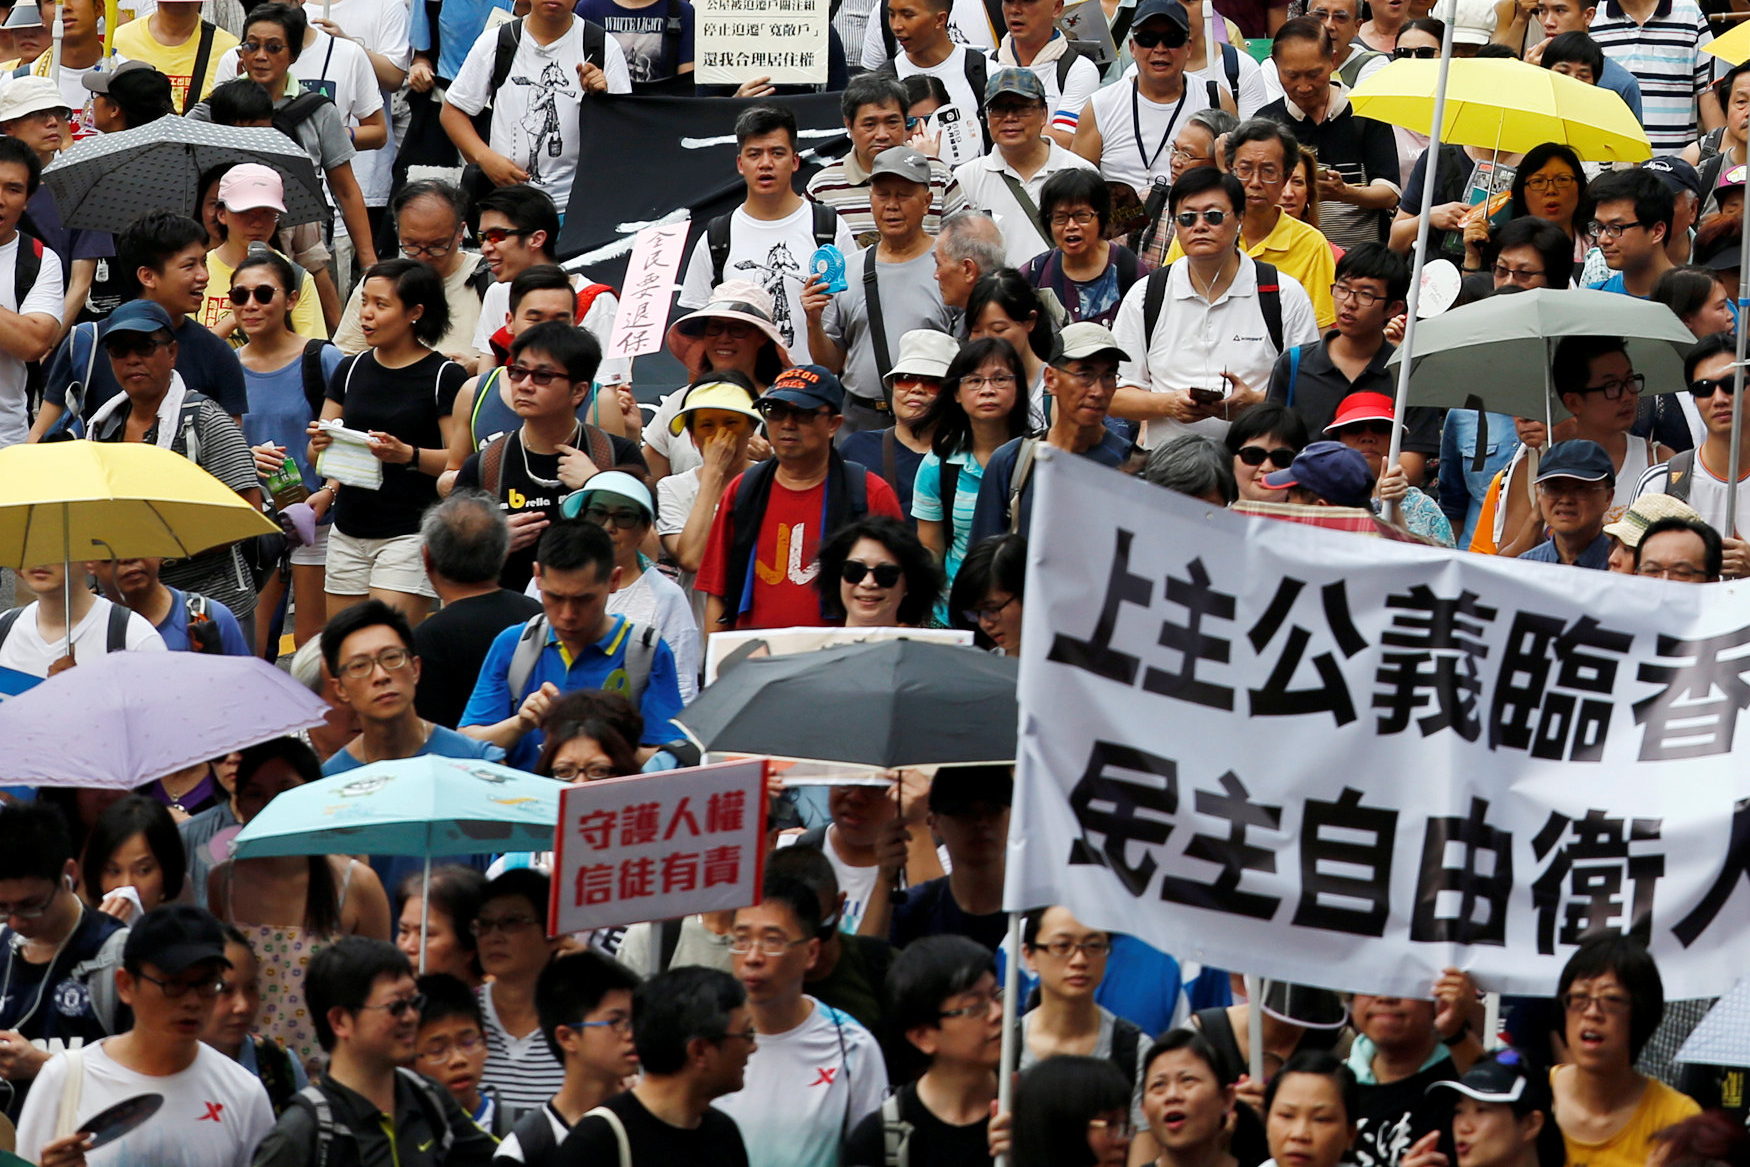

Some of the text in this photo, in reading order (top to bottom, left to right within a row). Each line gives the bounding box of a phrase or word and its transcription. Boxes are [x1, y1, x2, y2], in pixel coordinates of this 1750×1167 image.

[604, 16, 664, 33] WHITE LIGHT
[702, 51, 815, 68] 還我合理居住權
[576, 790, 744, 851] 守護人權
[573, 846, 741, 906] 信徒有責
